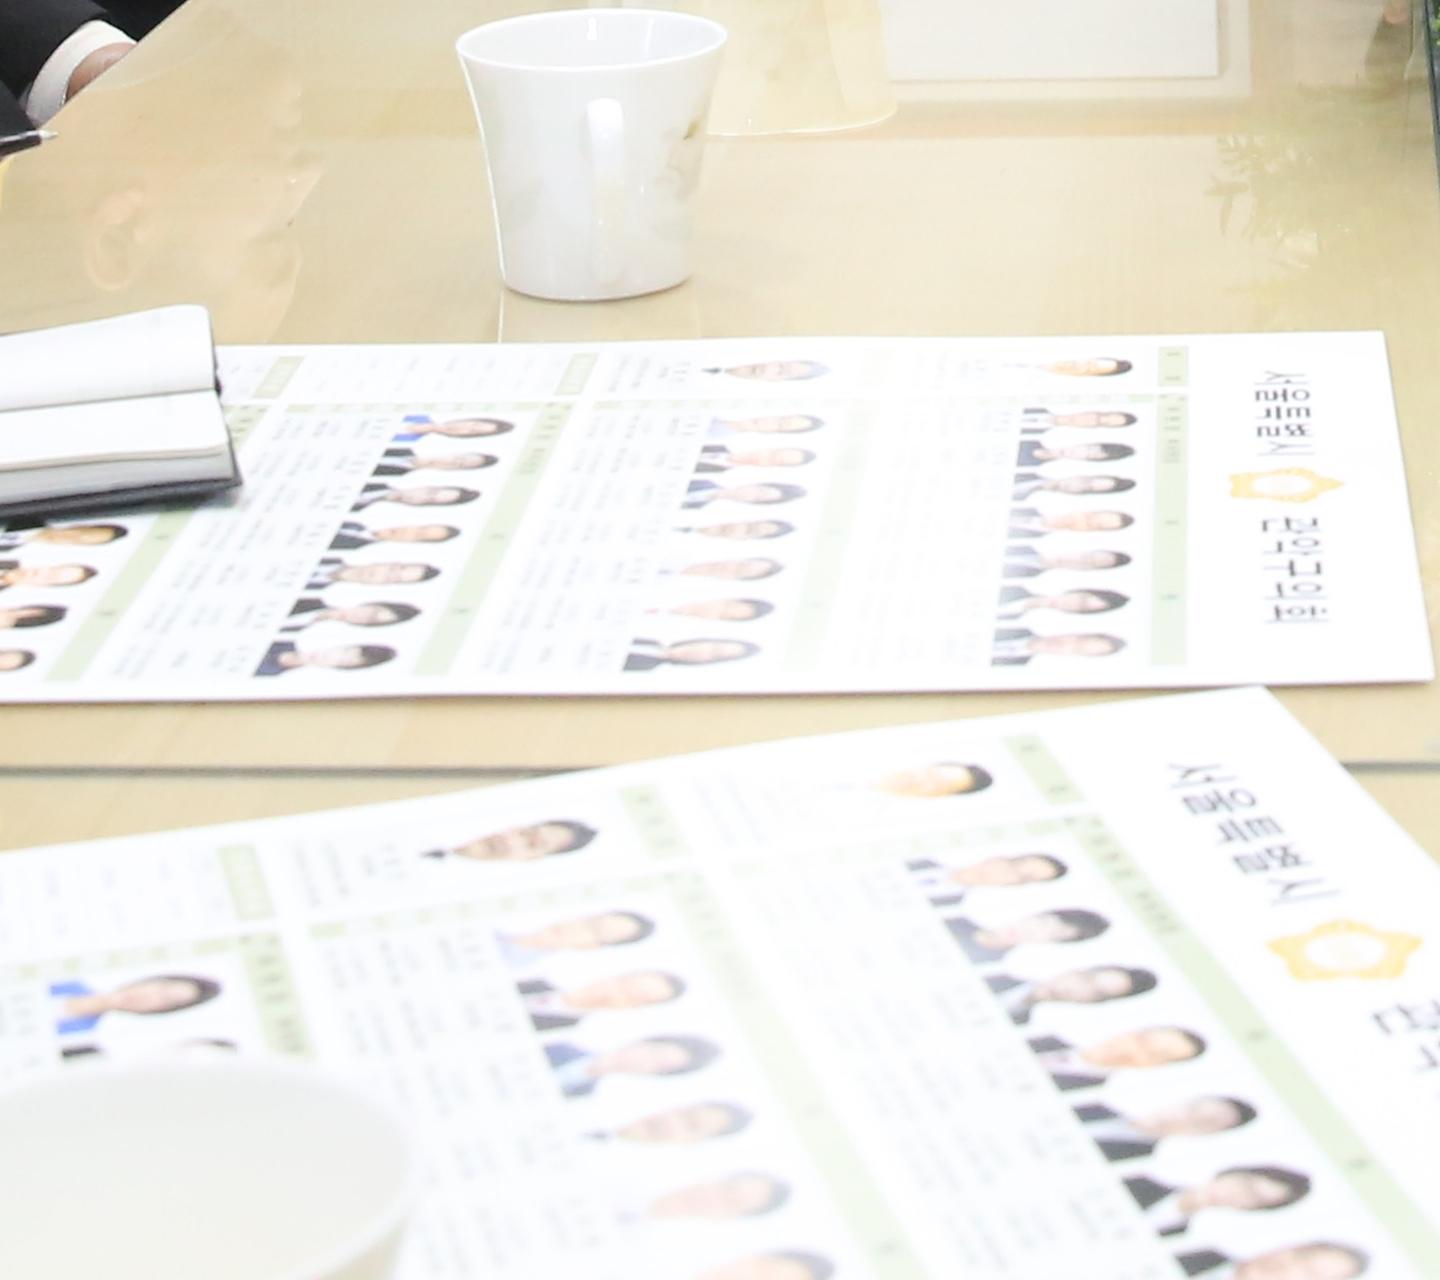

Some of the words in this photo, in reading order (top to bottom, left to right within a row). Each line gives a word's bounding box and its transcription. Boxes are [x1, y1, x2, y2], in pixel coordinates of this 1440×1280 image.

[1252, 369, 1317, 458] 서울특별시
[1260, 514, 1331, 624] 관악구의회
[1168, 761, 1345, 906] 서울특별시
